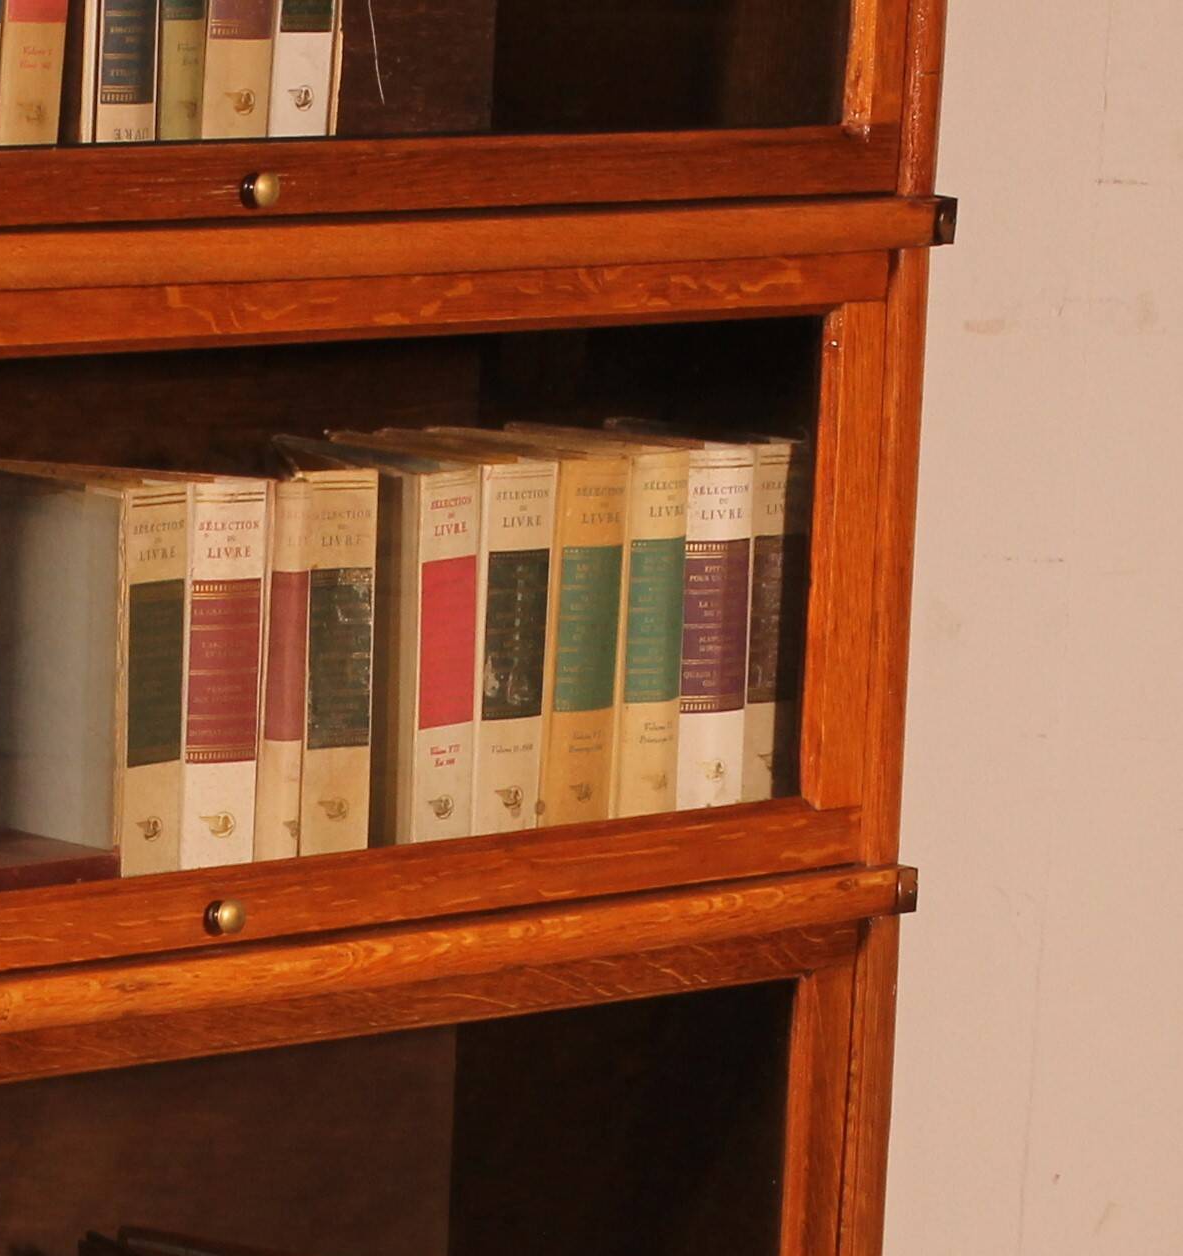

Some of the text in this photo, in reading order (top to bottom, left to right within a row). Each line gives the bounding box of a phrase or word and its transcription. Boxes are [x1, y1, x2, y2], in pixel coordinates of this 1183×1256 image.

[701, 508, 743, 520] LIVRE
[503, 515, 542, 528] LIVRE
[434, 521, 468, 537] LIVRE
[139, 546, 176, 561] LIVRE
[207, 546, 252, 559] LIVRE
